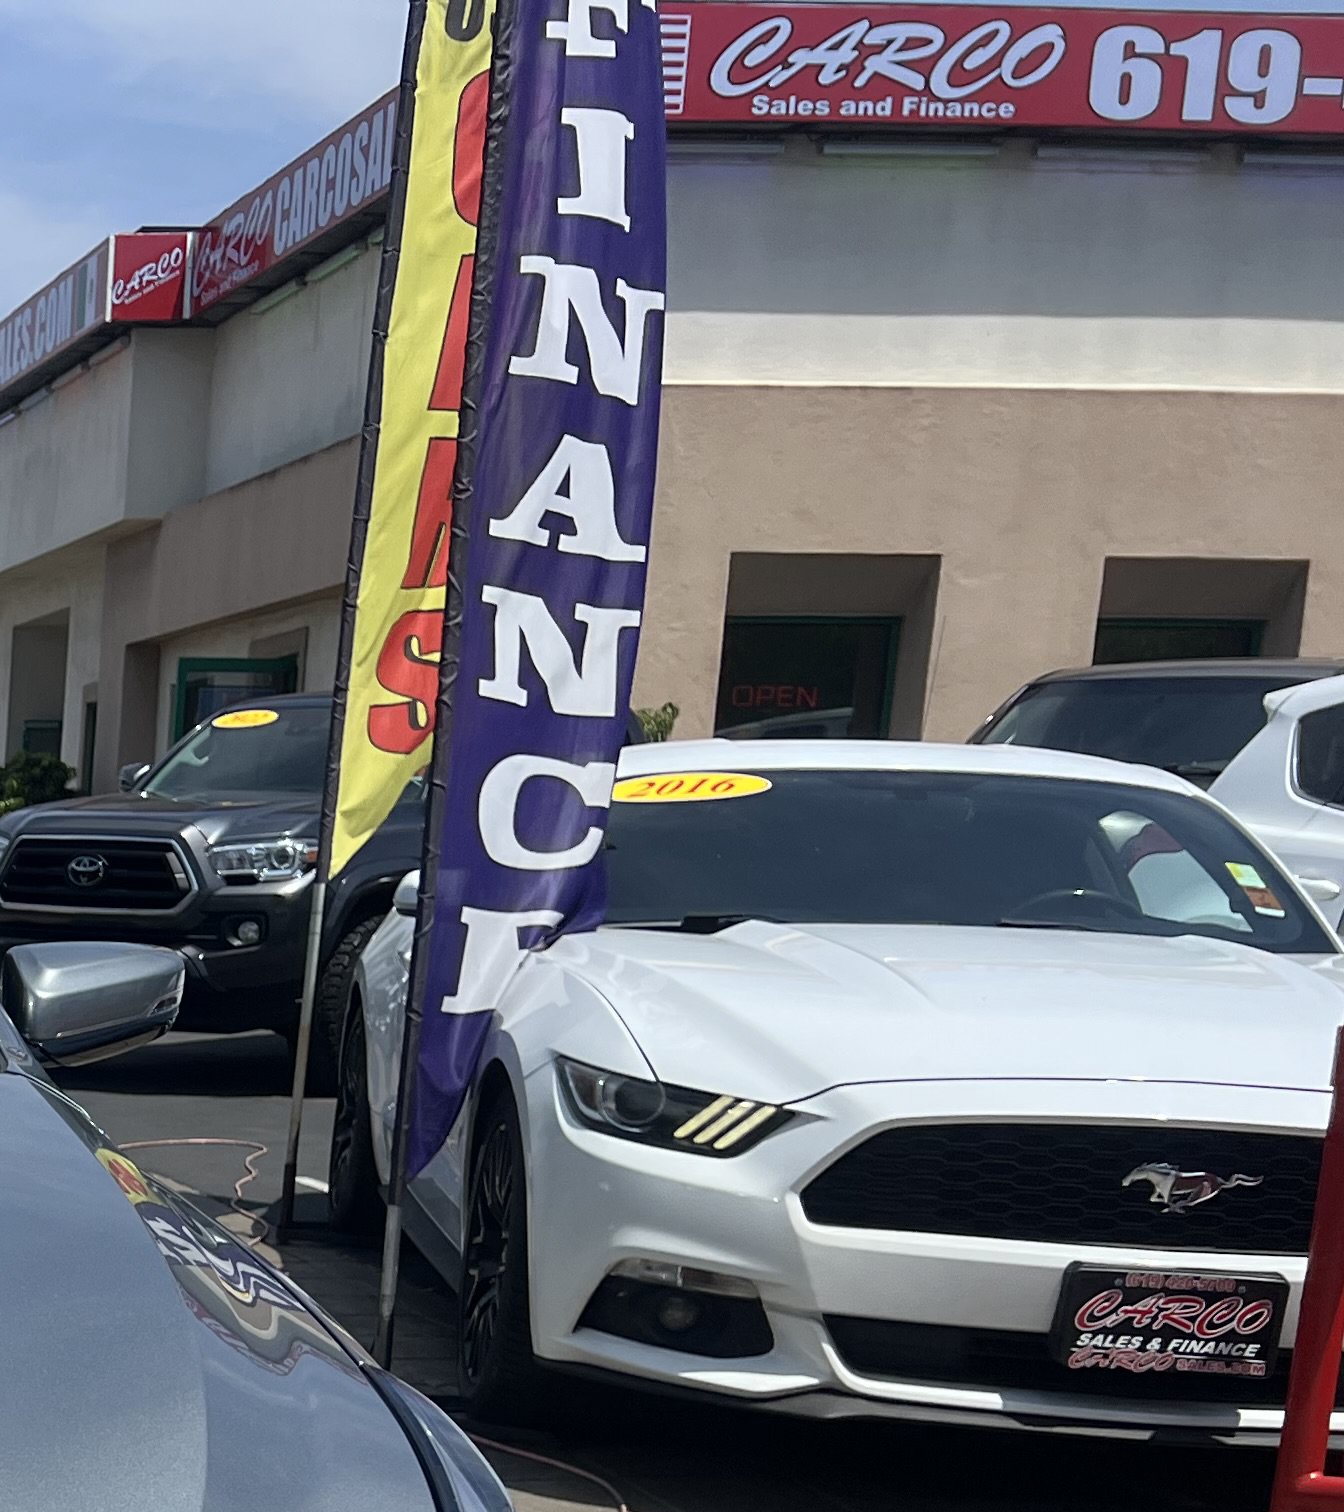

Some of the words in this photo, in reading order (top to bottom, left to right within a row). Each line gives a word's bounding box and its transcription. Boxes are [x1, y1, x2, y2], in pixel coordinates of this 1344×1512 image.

[710, 15, 1067, 99] CARCO
[751, 94, 831, 116] Sales
[839, 97, 893, 117] and
[901, 96, 1016, 119] Finance
[192, 188, 274, 298] CARCO
[111, 246, 184, 305] CARCO
[732, 685, 818, 708] OPEN
[626, 777, 738, 799] 2016
[1074, 1289, 1272, 1338] CARCO
[1076, 1333, 1144, 1350] SALES
[1146, 1336, 1162, 1351] &
[1167, 1338, 1261, 1358] FINANCE
[1068, 1347, 1176, 1373] CARCO
